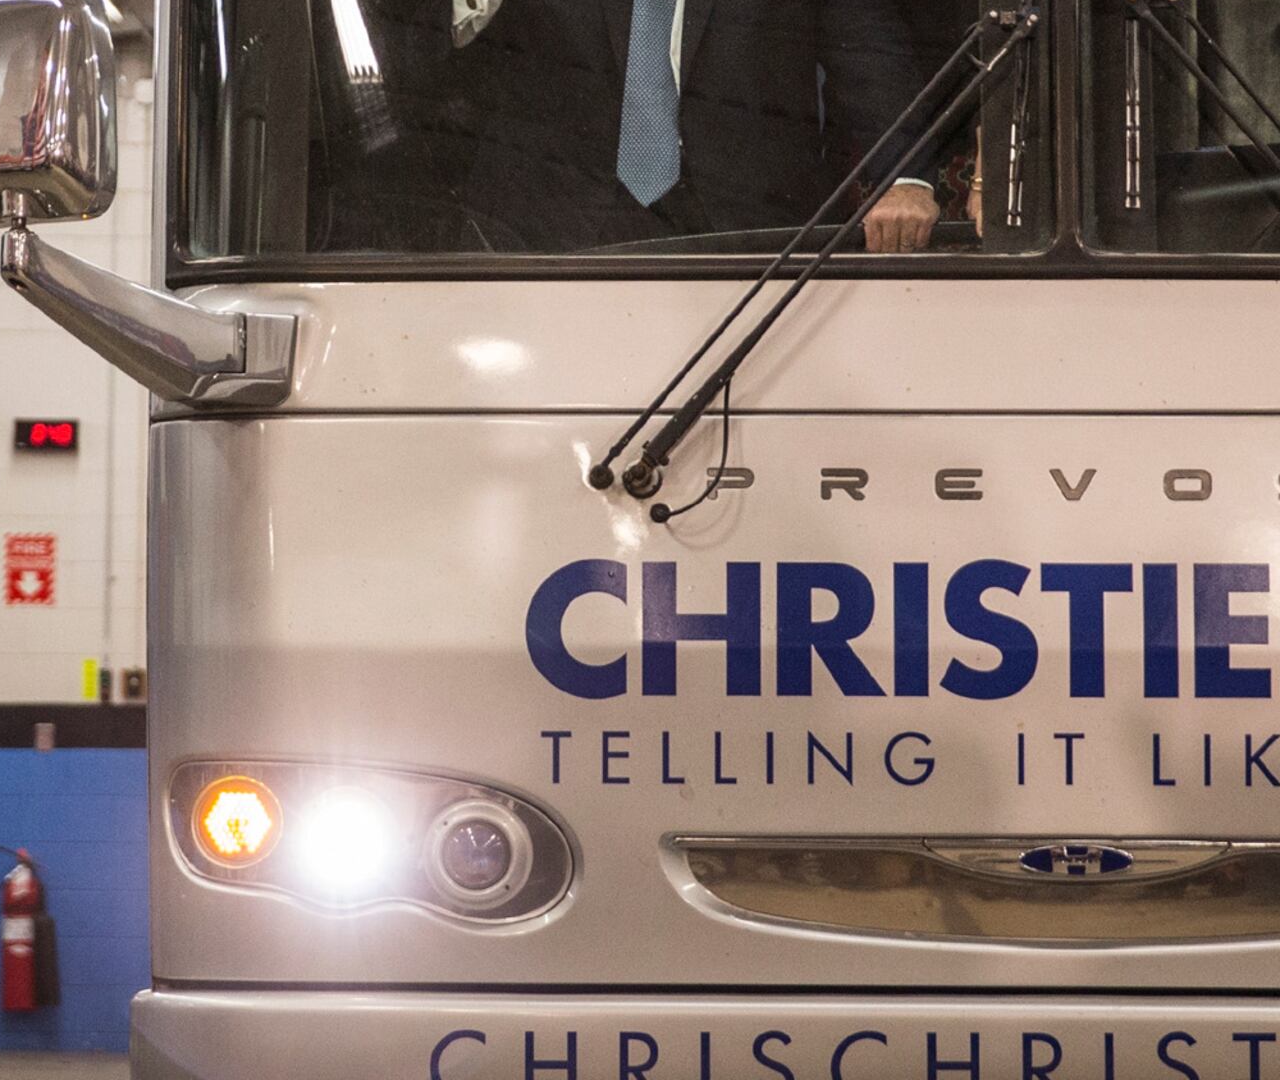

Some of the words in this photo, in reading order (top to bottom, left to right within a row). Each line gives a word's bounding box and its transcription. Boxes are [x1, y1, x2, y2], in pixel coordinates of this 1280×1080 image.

[524, 558, 1272, 700] CHRISTIE
[540, 730, 936, 787] TELLING
[1017, 732, 1086, 786] IT
